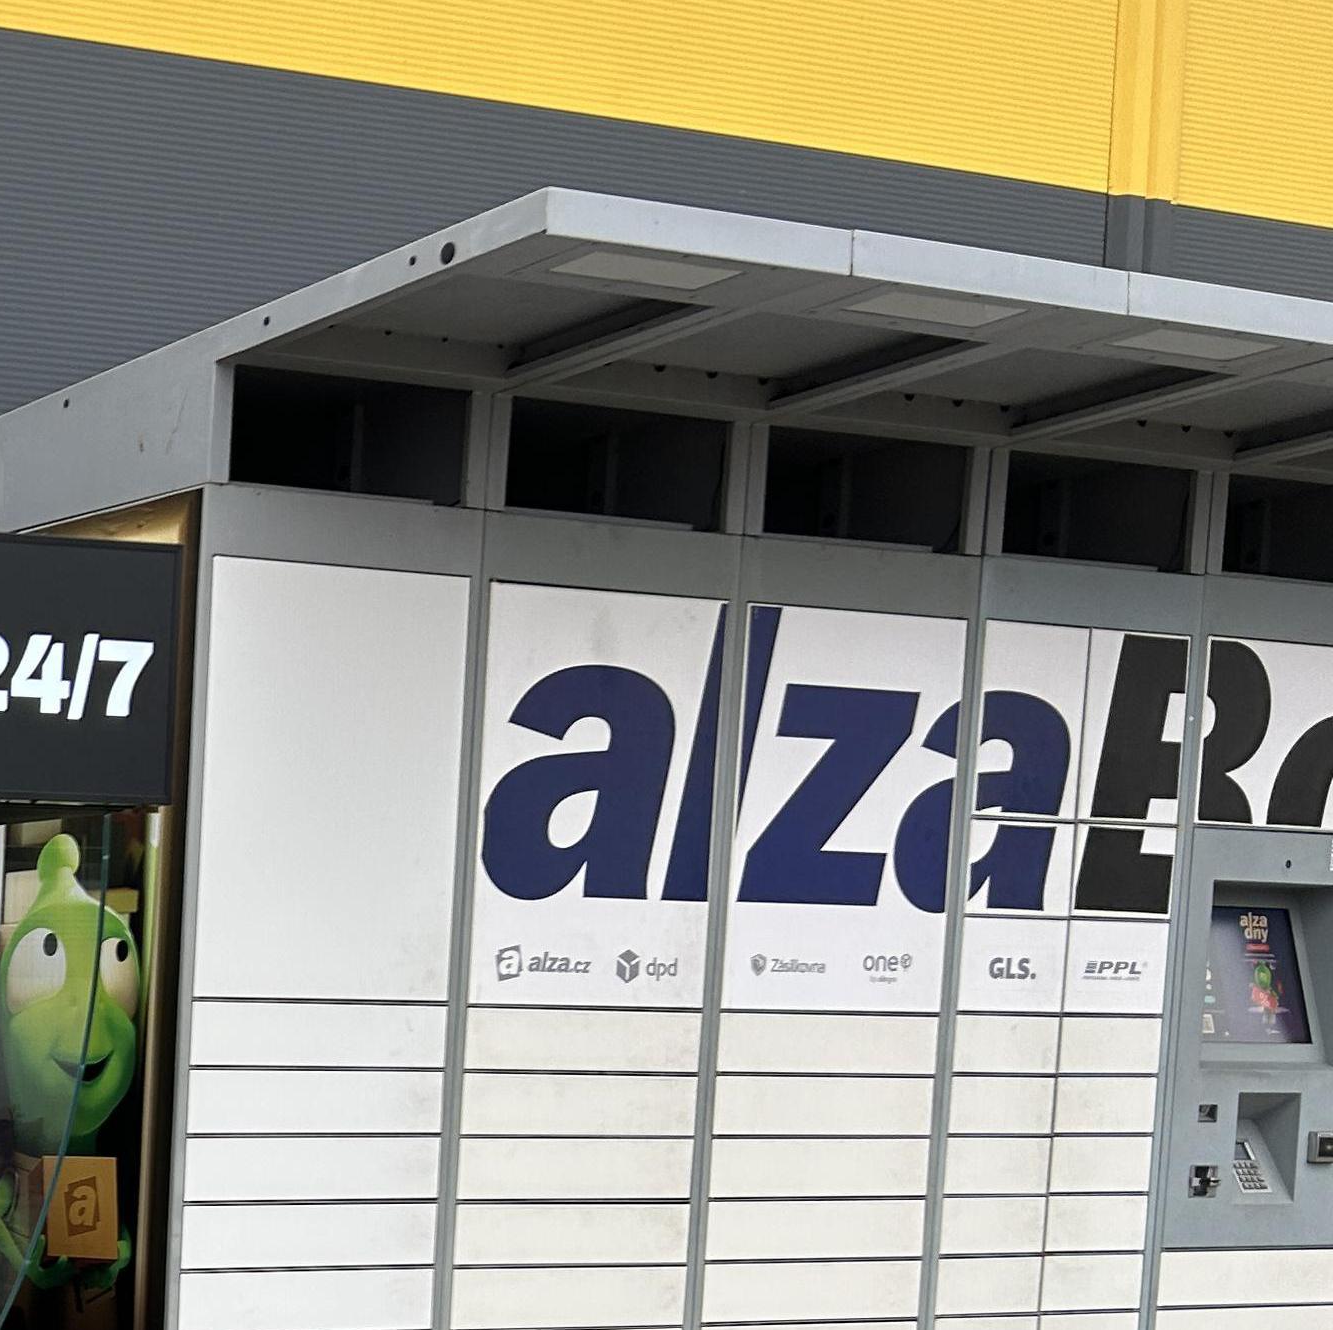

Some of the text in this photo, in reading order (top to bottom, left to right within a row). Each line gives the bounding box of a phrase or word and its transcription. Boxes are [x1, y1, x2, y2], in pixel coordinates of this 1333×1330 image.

[480, 600, 1333, 916] alzaB
[1239, 912, 1268, 928] alza
[1243, 927, 1269, 944] dny
[528, 951, 592, 974] alza.cz
[645, 956, 678, 982] dpd
